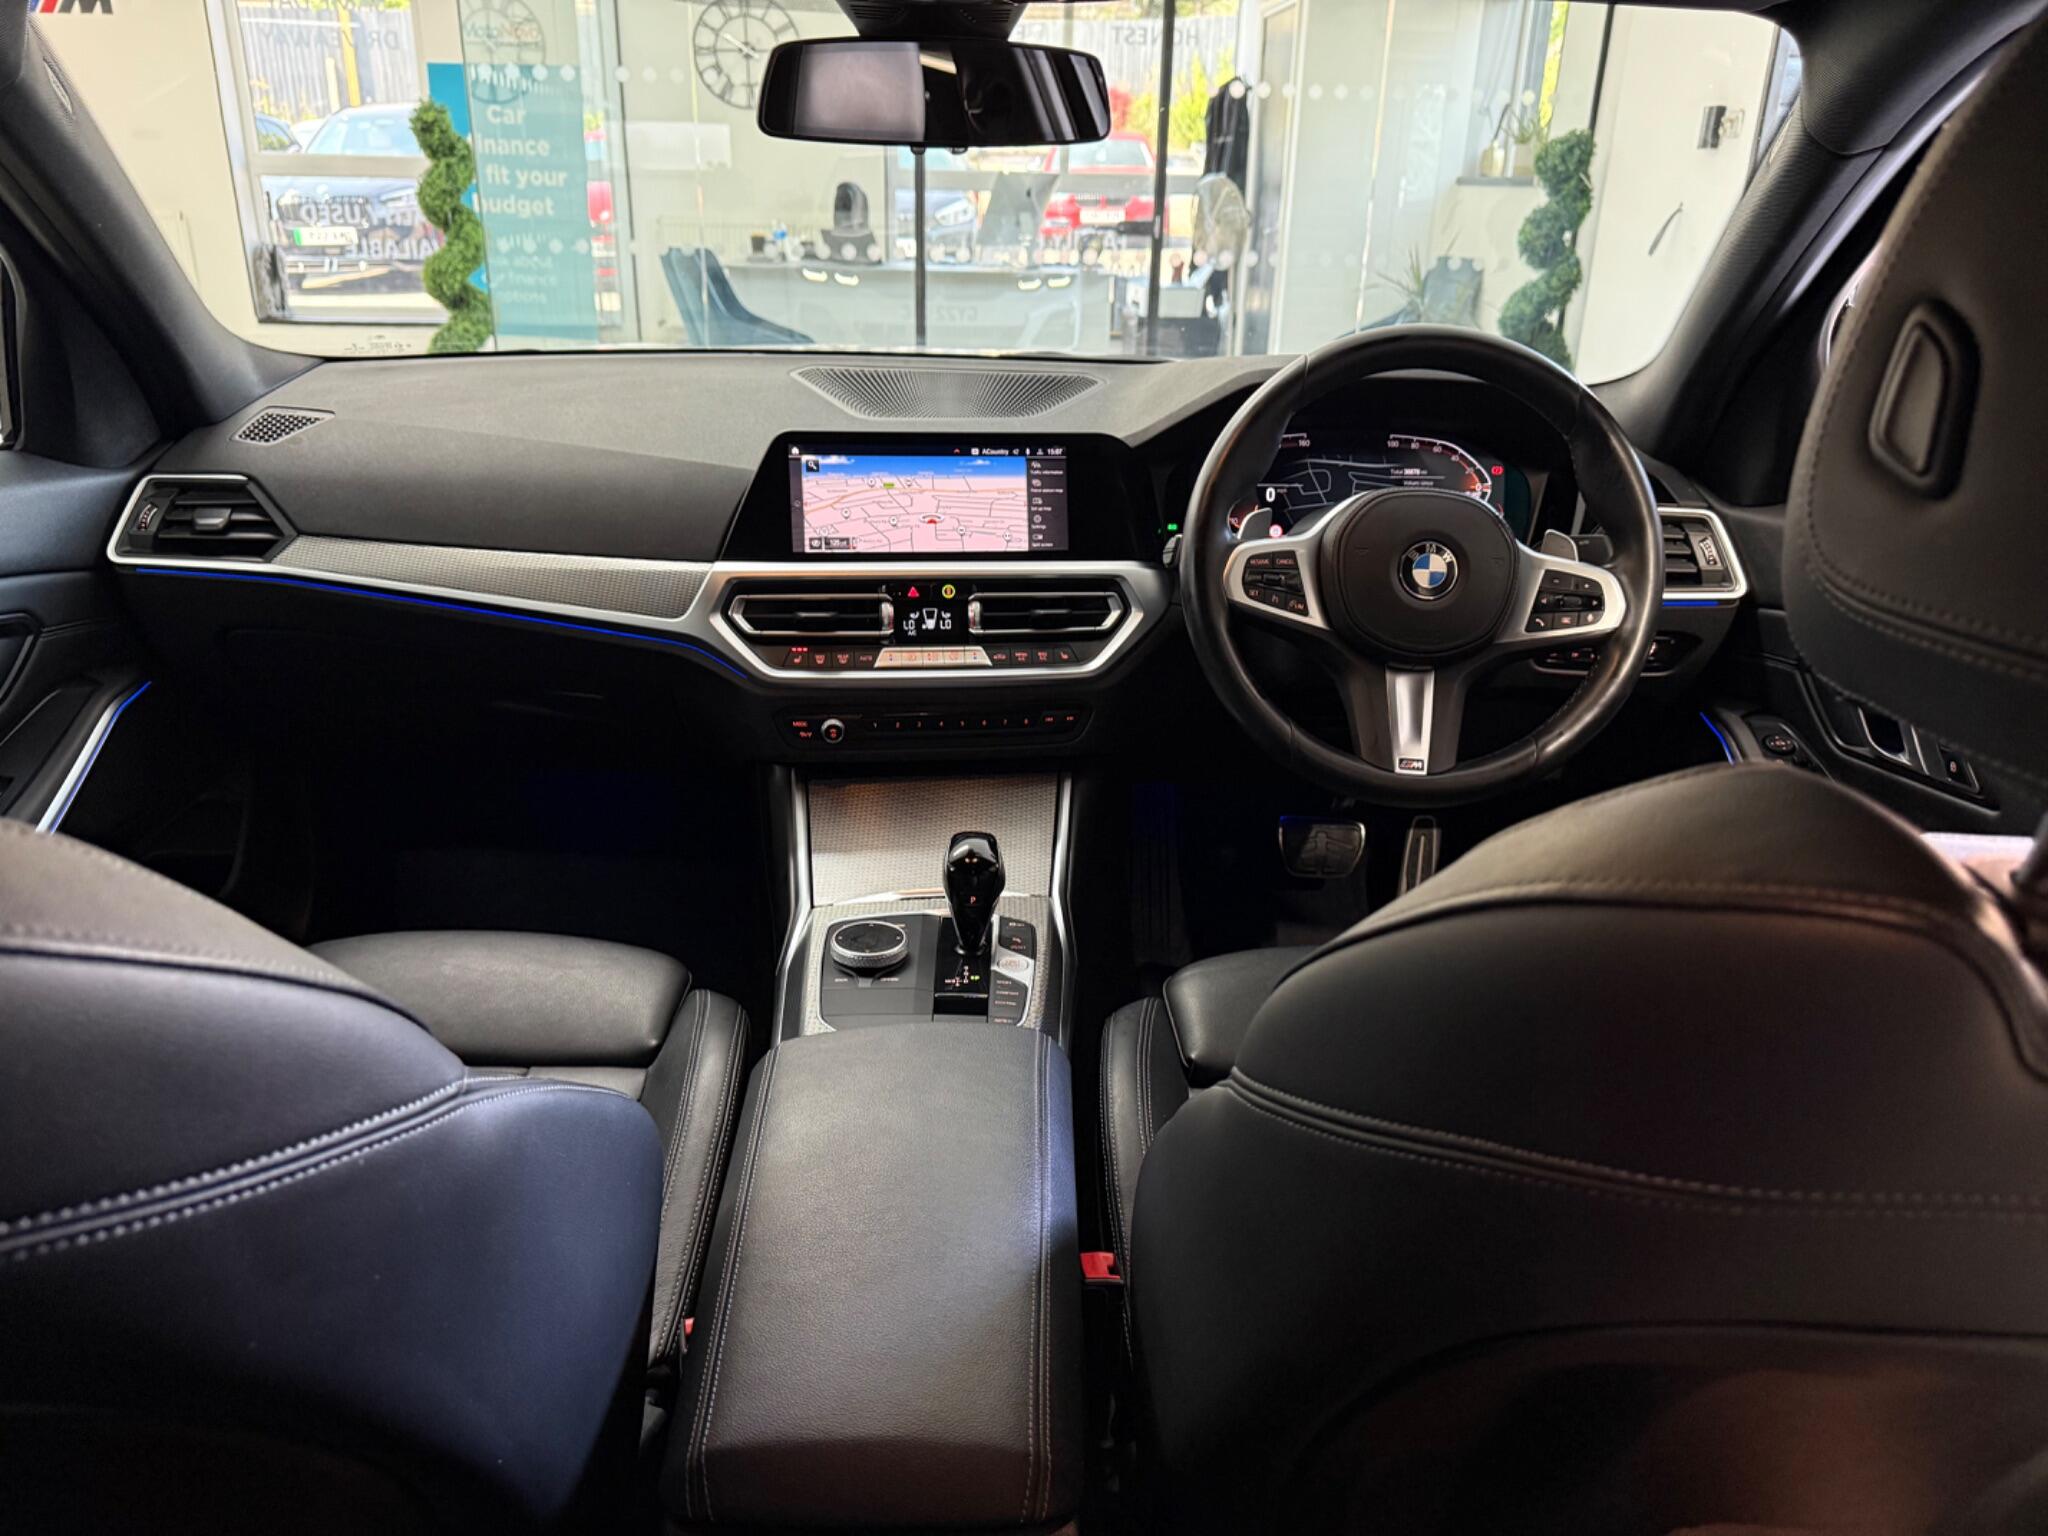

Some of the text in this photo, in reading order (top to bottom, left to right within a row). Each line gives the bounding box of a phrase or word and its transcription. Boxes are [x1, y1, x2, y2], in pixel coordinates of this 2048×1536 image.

[486, 103, 527, 125] Car
[486, 163, 567, 190] fit your
[1265, 486, 1276, 503] 0
[1407, 543, 1453, 563] BMW
